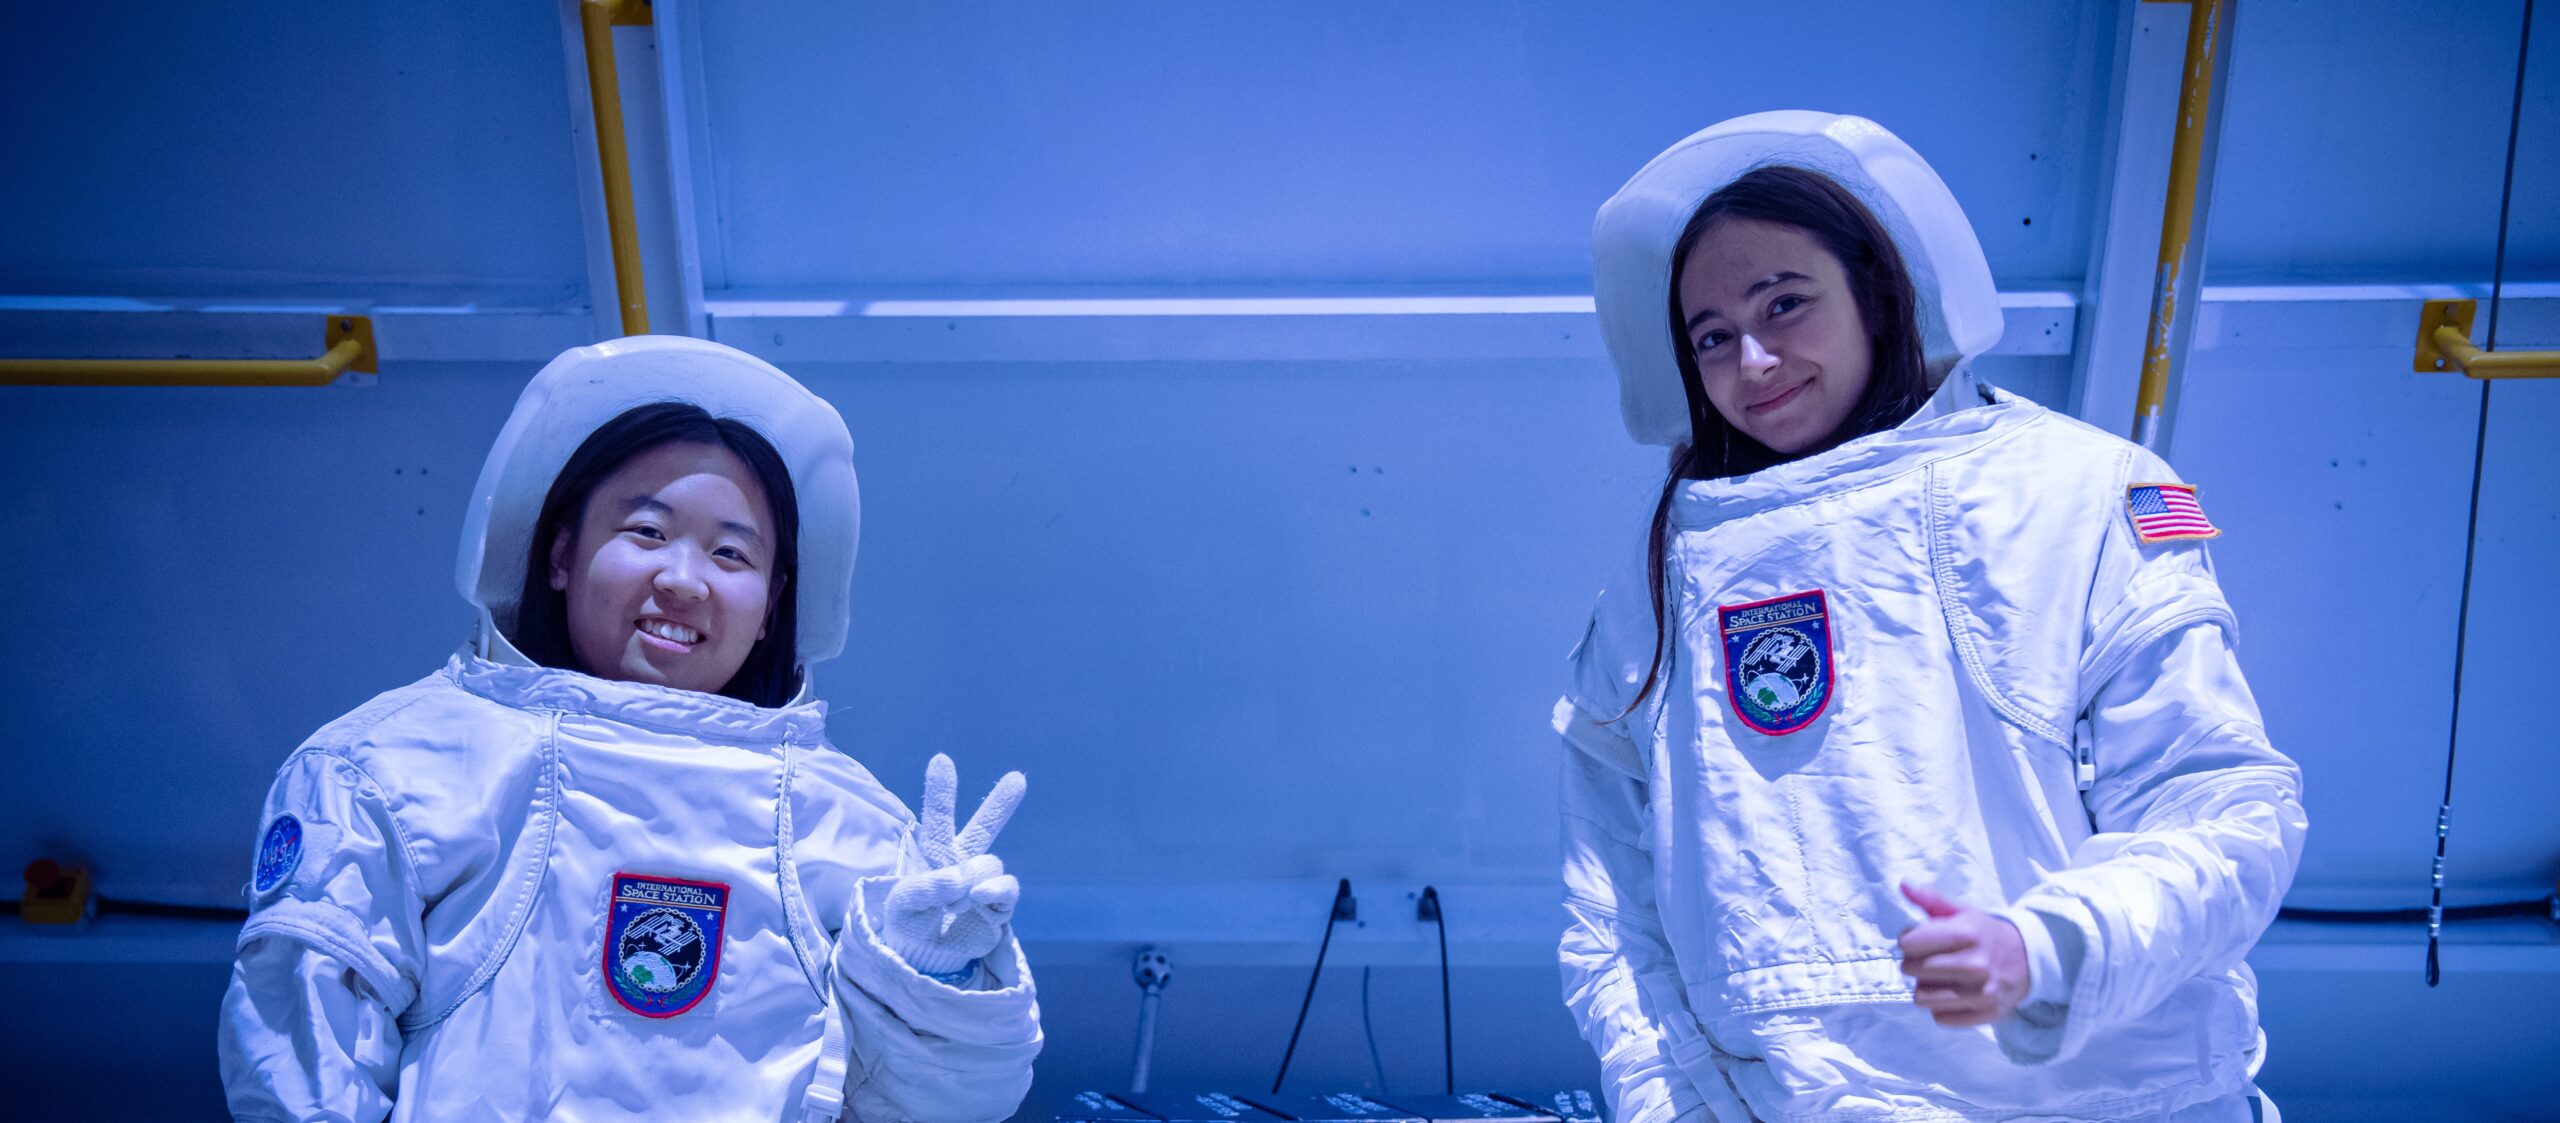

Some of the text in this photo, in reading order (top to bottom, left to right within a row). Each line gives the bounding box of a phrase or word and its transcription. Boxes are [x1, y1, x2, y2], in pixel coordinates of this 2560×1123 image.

[1729, 602, 1816, 628] SPACE STATION
[1742, 600, 1803, 618] INTERNATIONAL
[259, 842, 296, 870] NASA
[622, 885, 716, 905] SPACE STATION
[637, 882, 705, 896] INTERNATIONAL
